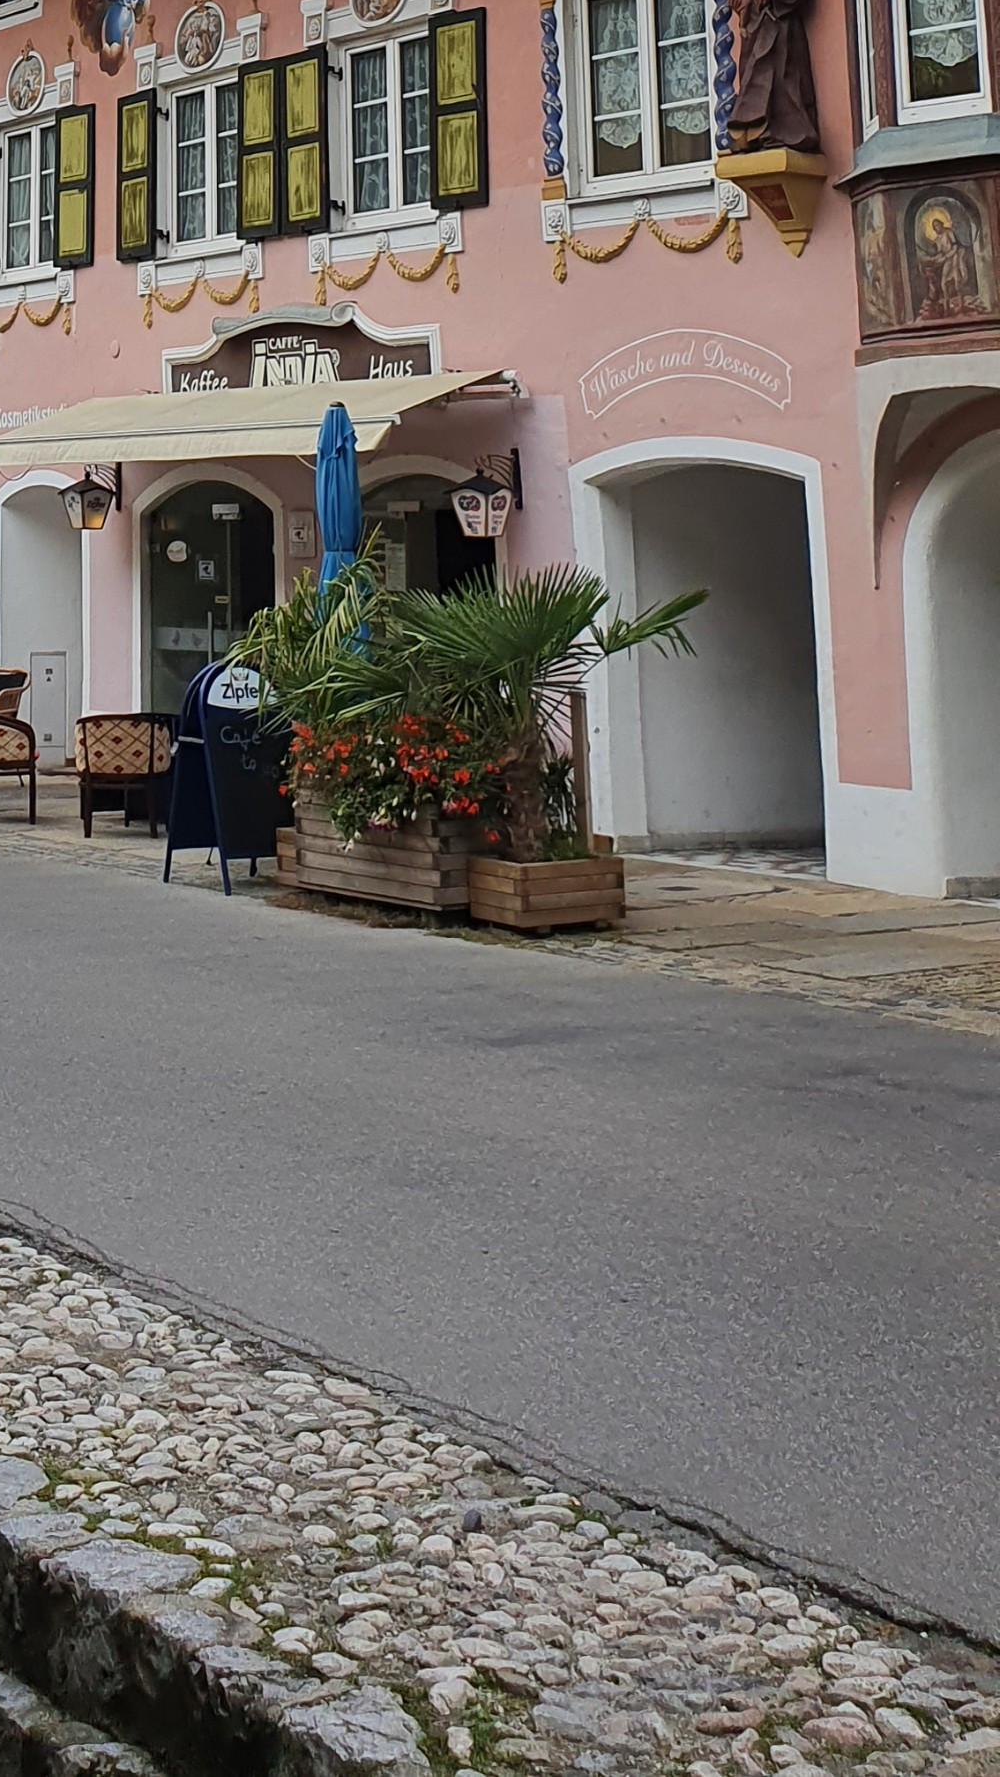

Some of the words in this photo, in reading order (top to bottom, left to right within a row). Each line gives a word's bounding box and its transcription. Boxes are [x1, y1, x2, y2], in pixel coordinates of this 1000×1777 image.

[179, 370, 229, 392] Kaffee
[368, 355, 414, 380] Haus
[589, 350, 655, 400] Wäsche
[659, 340, 696, 368] und
[703, 340, 781, 392] Dessous
[220, 683, 260, 704] Zipfe
